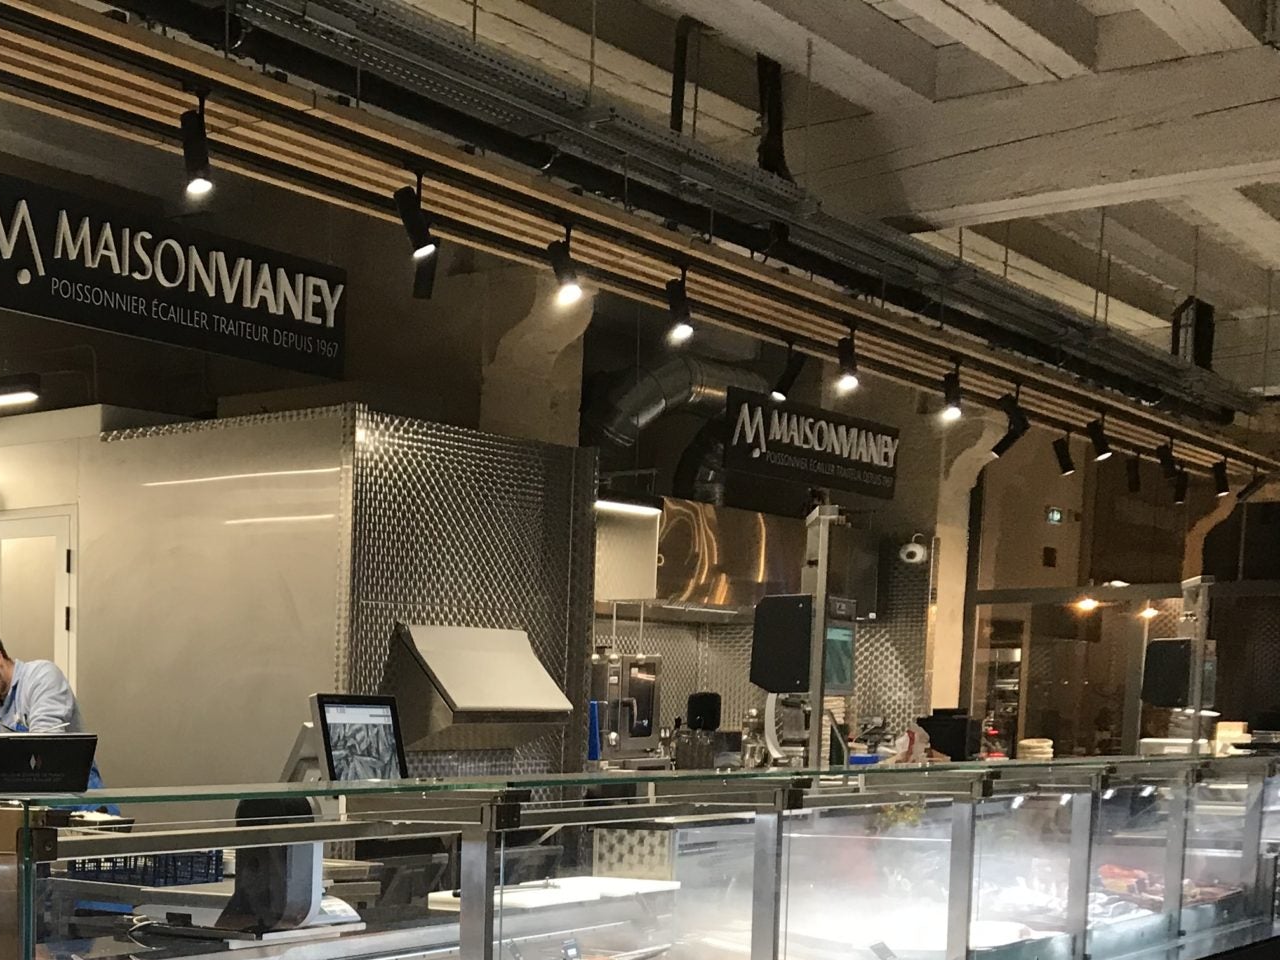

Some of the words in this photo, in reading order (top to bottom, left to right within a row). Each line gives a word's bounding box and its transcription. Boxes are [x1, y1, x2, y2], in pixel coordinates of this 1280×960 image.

[51, 277, 148, 317] POISSONNIER
[151, 298, 210, 332] ÉCAILLER
[213, 314, 270, 344] TRAITEUR
[272, 329, 314, 354] DEPUIS
[316, 340, 339, 359] 1967
[53, 209, 344, 328] MAISONVIANEY
